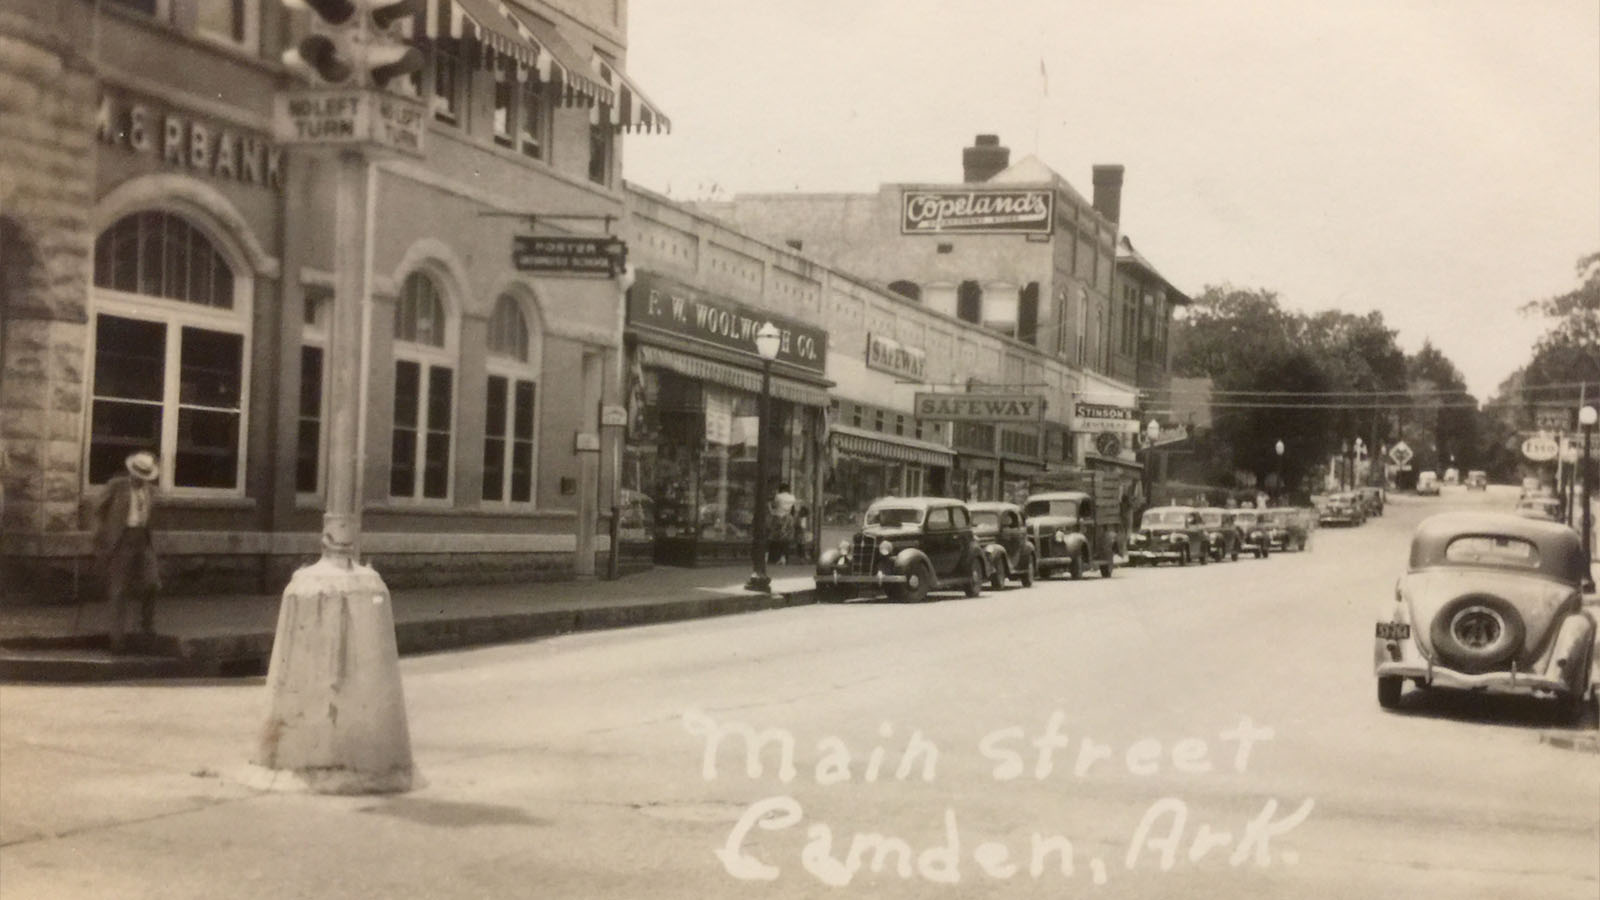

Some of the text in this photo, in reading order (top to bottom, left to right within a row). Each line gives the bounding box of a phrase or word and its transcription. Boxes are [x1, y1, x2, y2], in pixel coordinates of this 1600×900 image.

[312, 98, 359, 116] LEFT
[295, 119, 353, 138] TURN
[908, 192, 1047, 231] Copeland's
[648, 289, 818, 361] F. W. WOOLWOH CO.
[872, 340, 925, 377] SAFEWAY
[921, 399, 1036, 417] SAFEWAY
